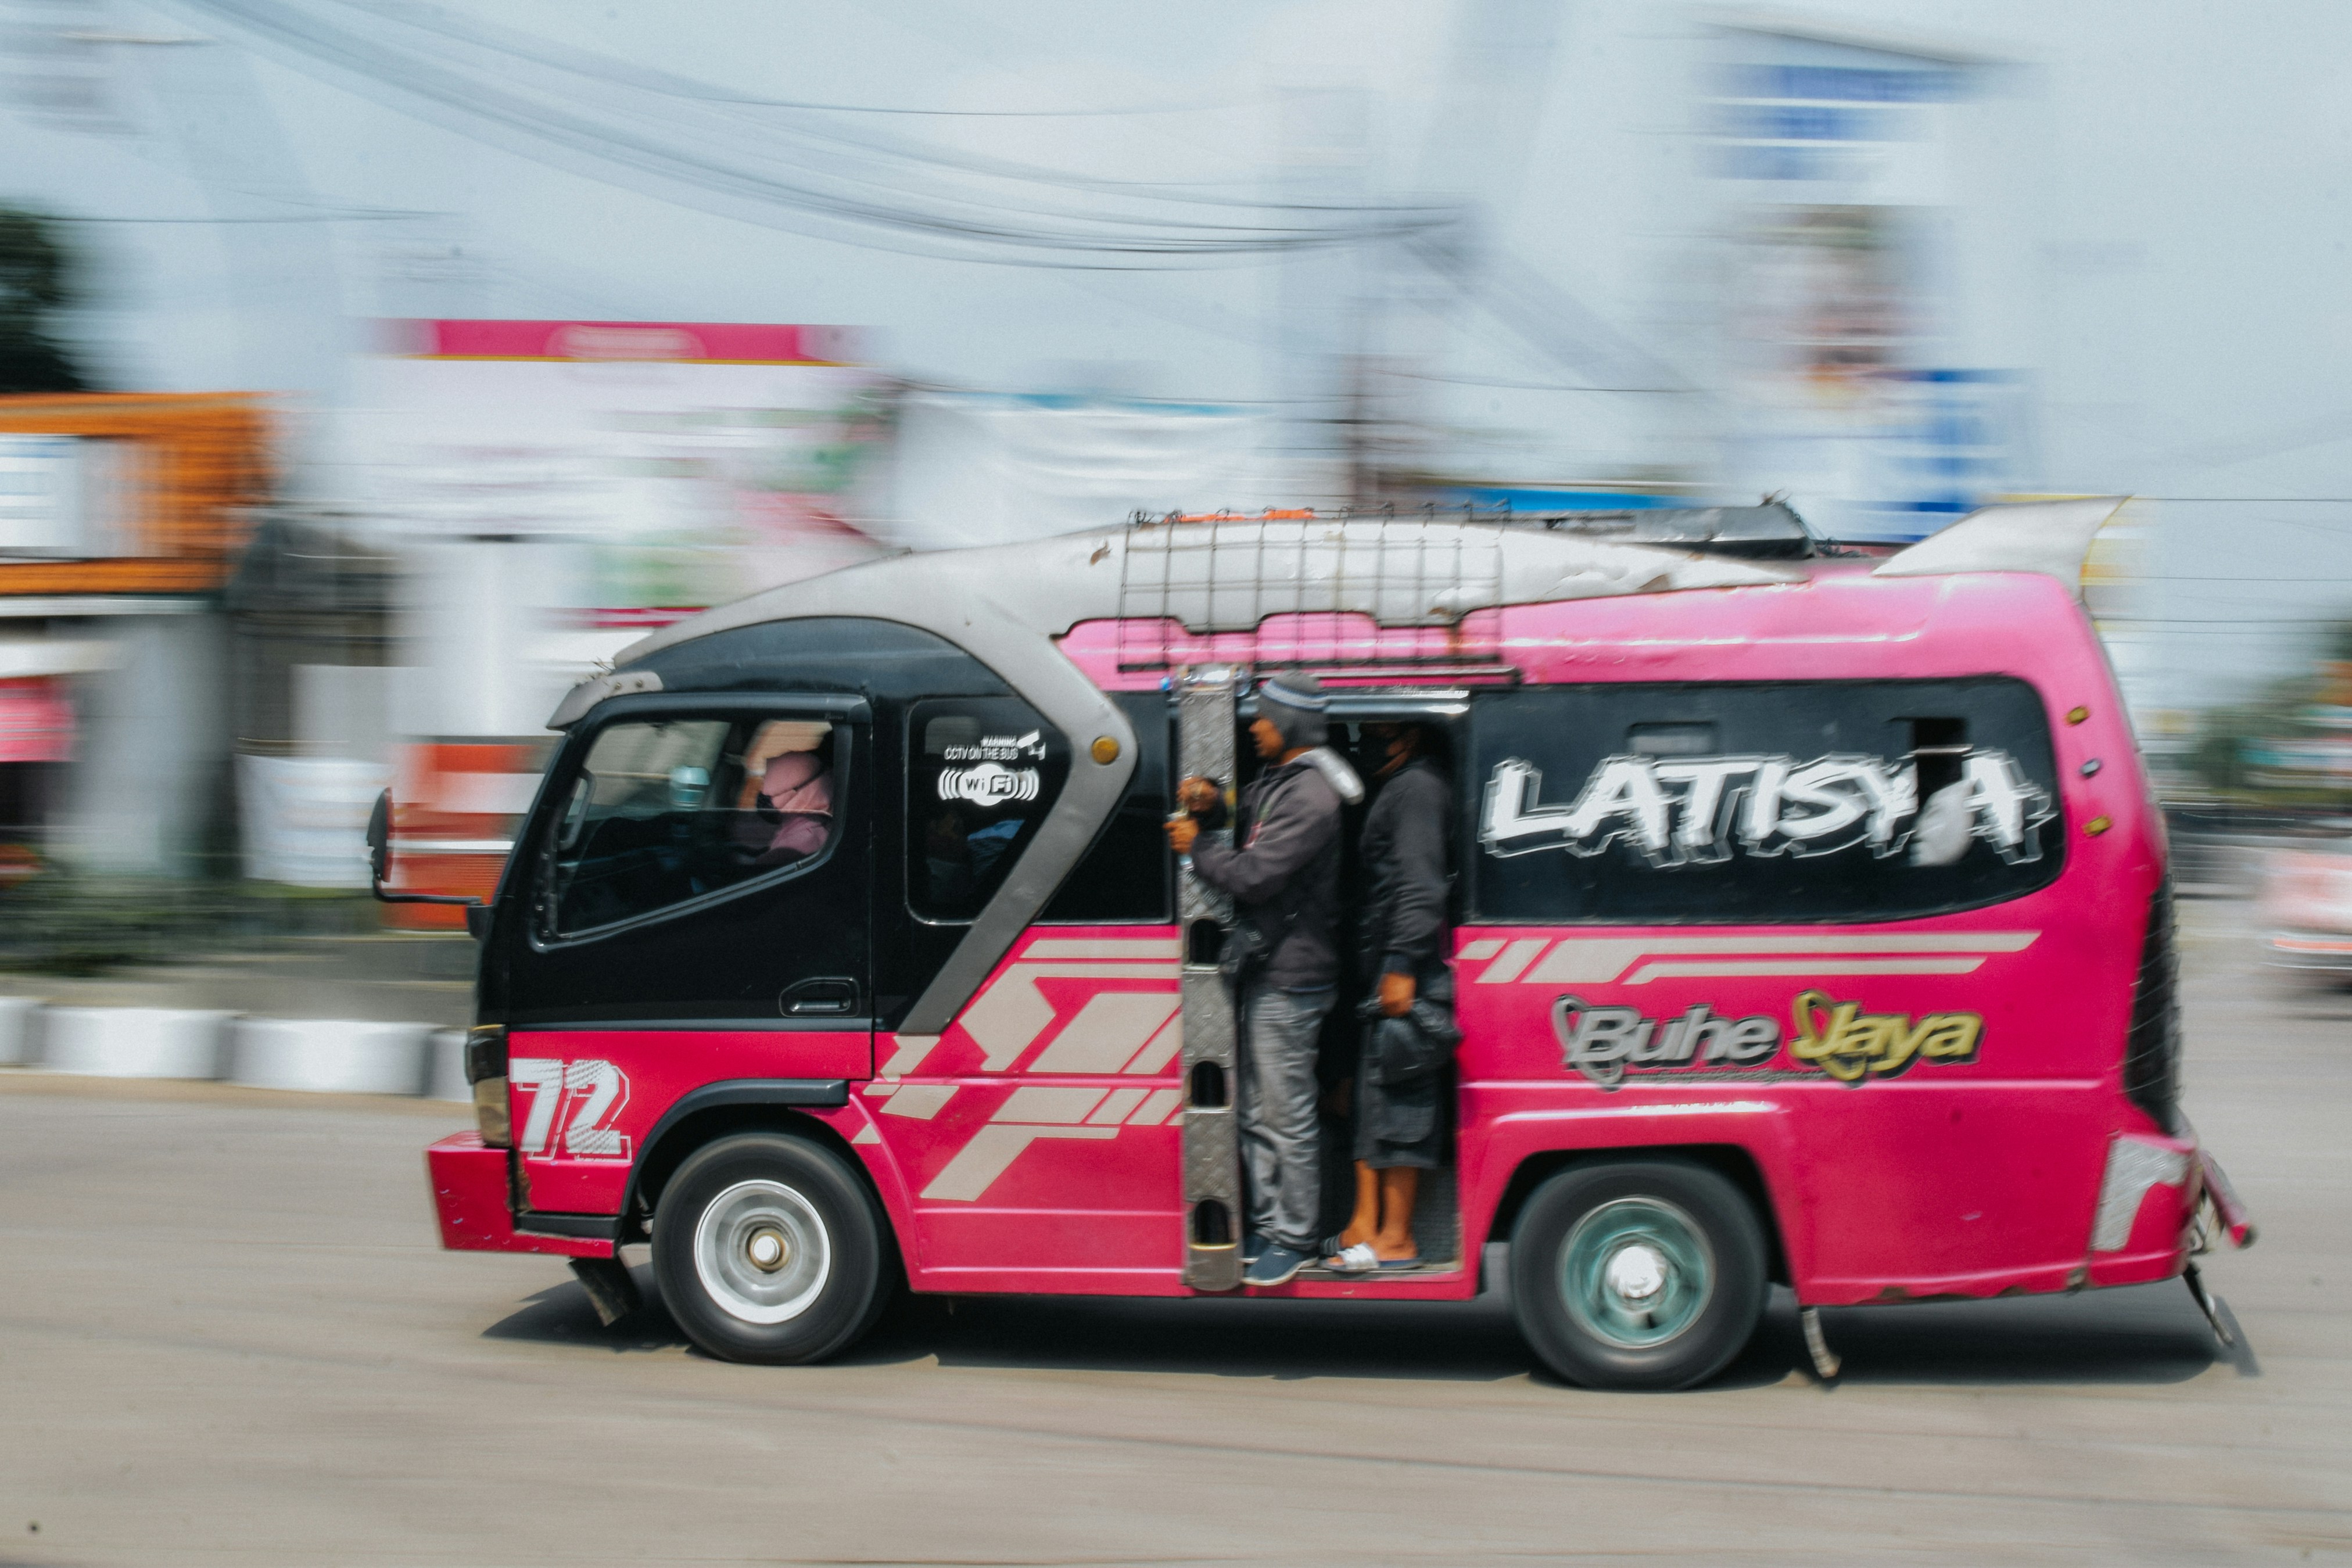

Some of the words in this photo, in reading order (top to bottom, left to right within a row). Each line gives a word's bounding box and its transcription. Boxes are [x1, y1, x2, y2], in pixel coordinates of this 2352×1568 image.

[944, 745, 968, 760] CCTV
[968, 745, 982, 760] ON
[982, 747, 999, 760] THE
[999, 747, 1019, 760] BUS
[981, 735, 1017, 747] WARNING
[1551, 993, 1779, 1092] Buhe
[1788, 989, 1982, 1085] Jaya
[510, 1059, 632, 1162] 72
